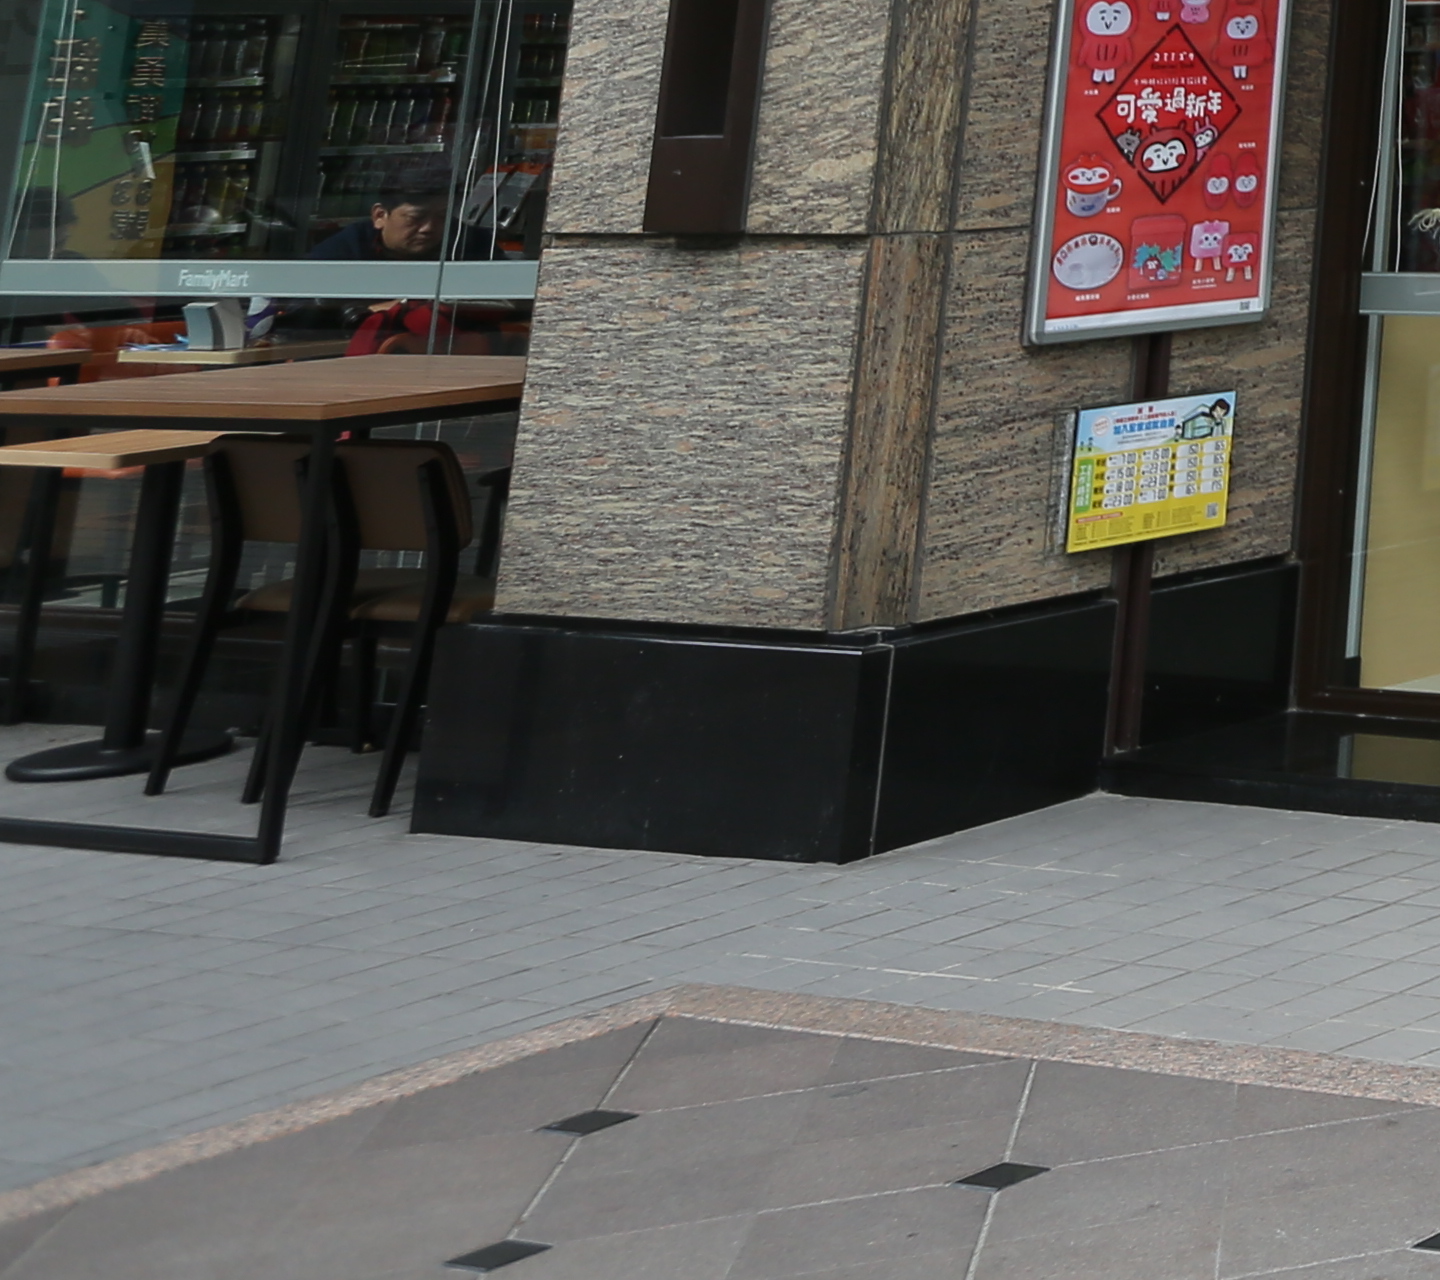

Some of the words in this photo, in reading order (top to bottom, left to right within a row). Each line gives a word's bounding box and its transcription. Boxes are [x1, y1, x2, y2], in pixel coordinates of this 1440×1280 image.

[1116, 86, 1222, 124] 可愛過新年
[178, 267, 250, 291] FamilyMart
